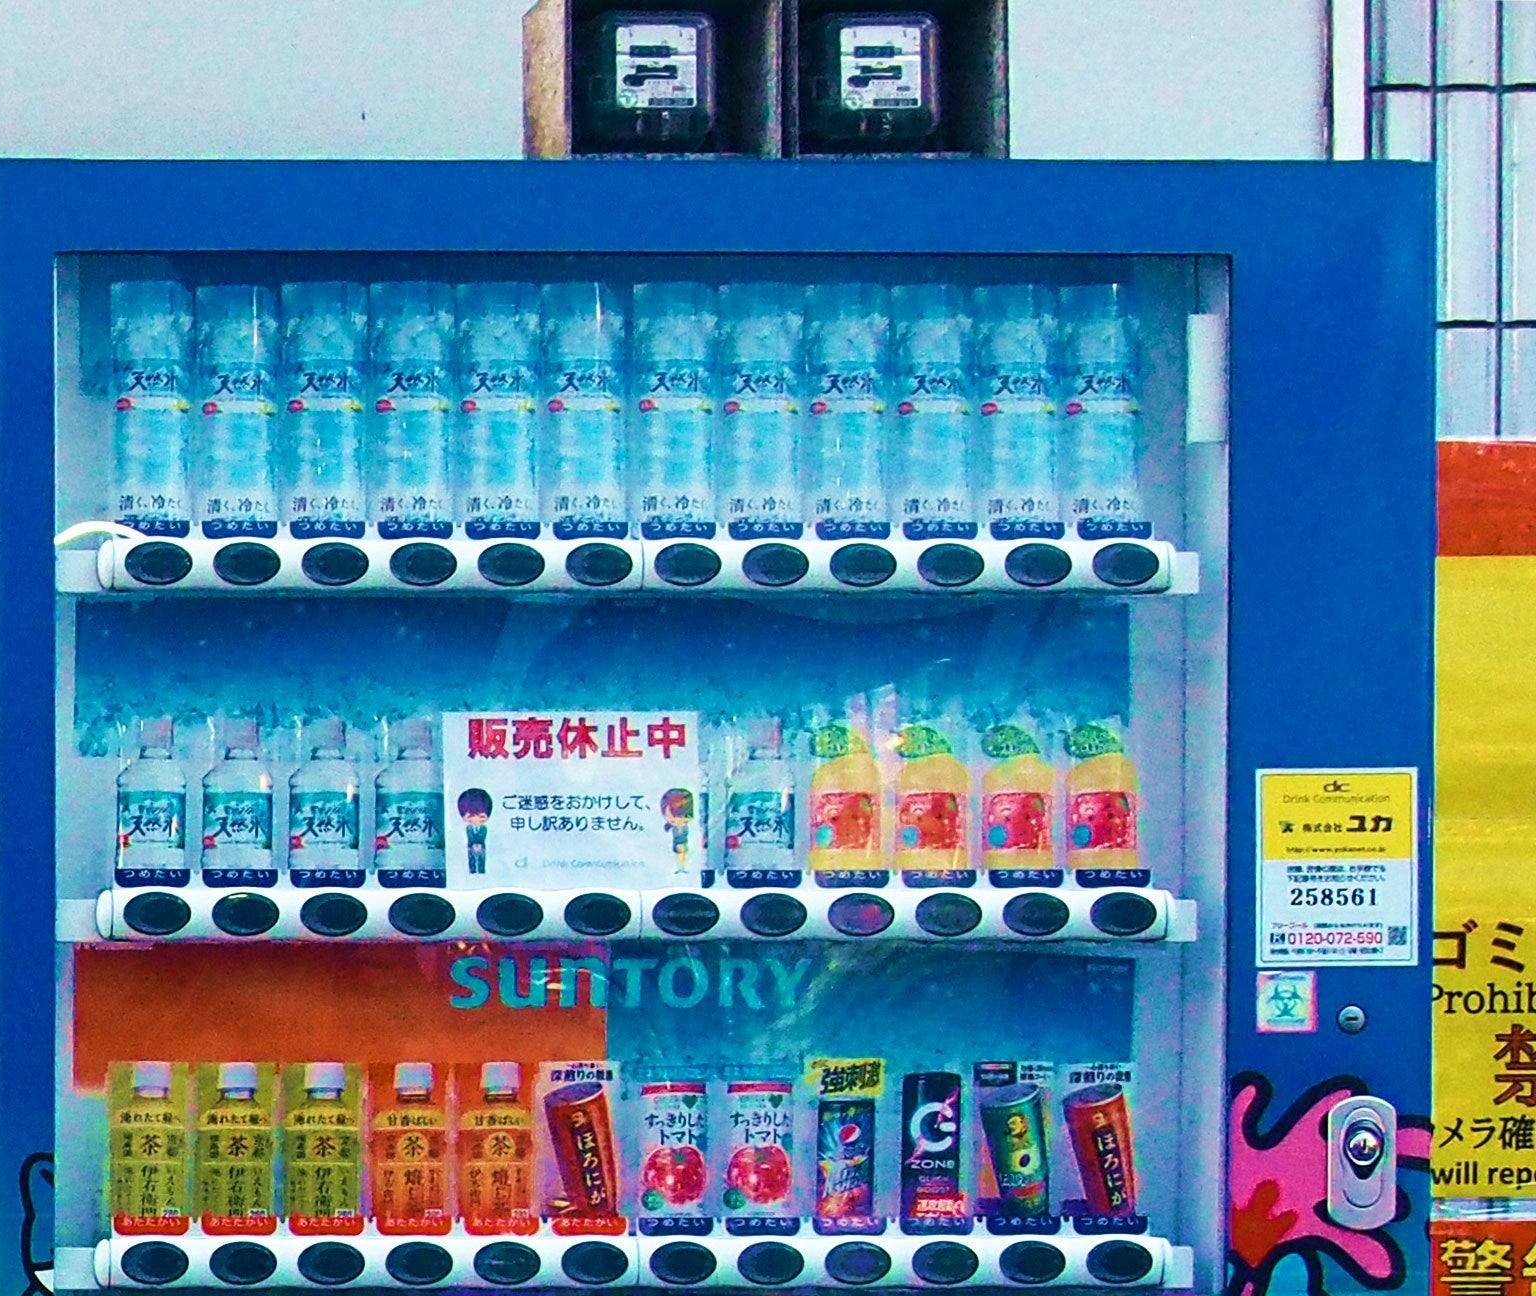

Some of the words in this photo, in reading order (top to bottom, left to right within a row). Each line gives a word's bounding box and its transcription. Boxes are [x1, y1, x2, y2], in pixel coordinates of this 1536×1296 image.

[467, 716, 686, 760] 販売休止中
[1346, 815, 1394, 832] ユカ
[1289, 887, 1379, 907] 258561
[1288, 931, 1383, 946] 0120-072-590
[658, 1130, 698, 1145] トマト
[743, 1130, 782, 1145] トマト
[1432, 1162, 1478, 1185] will
